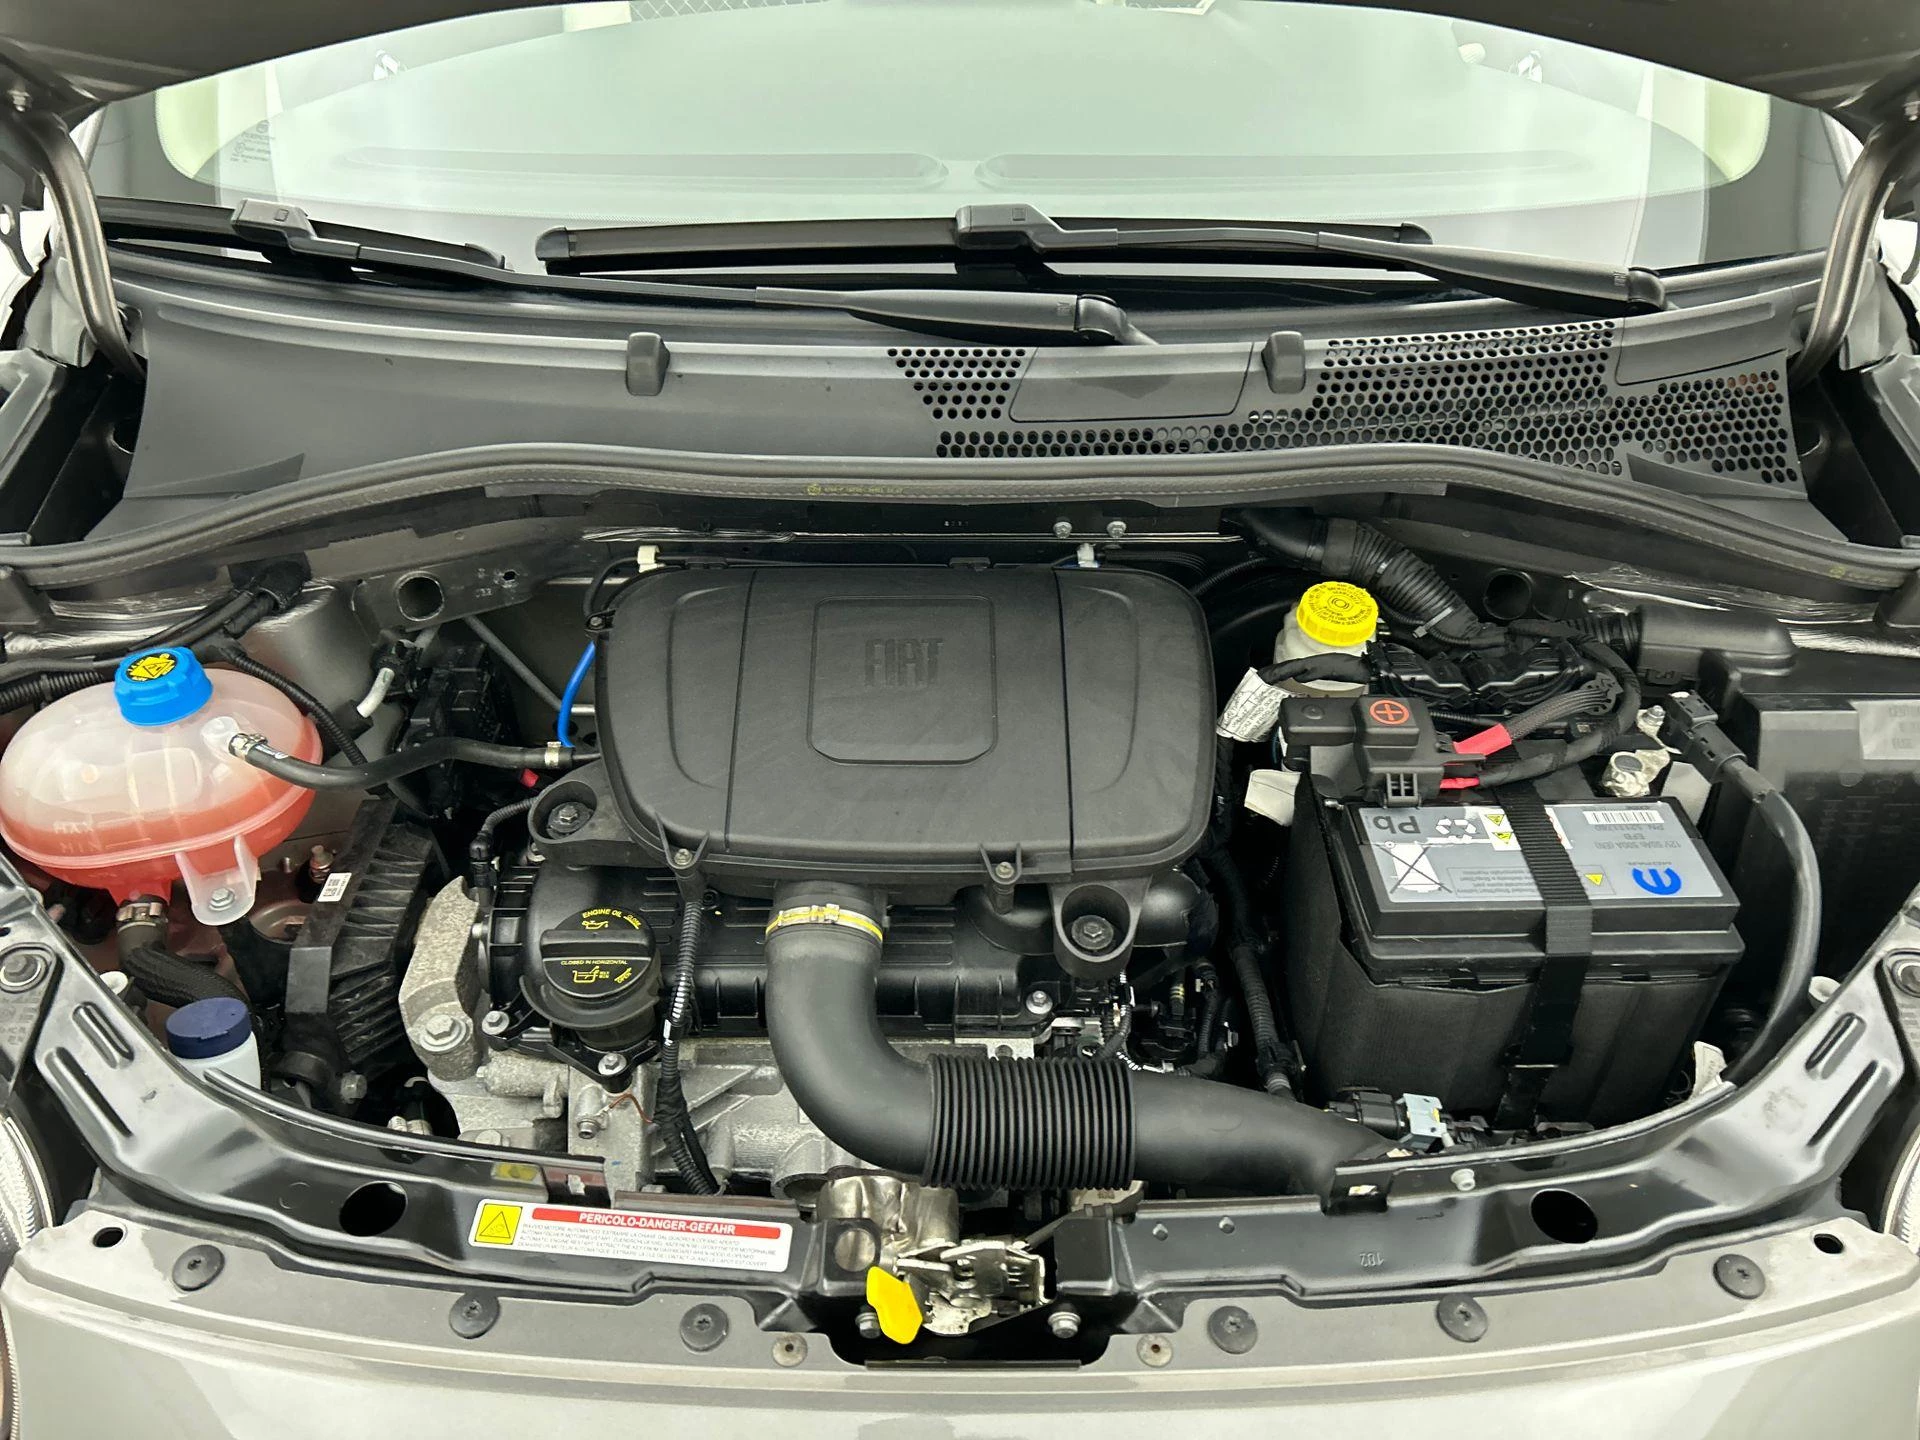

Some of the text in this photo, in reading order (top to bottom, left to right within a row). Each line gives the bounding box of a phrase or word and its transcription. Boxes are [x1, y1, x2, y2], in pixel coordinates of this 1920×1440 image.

[865, 638, 943, 687] FIAT
[53, 821, 94, 834] MAX
[1373, 815, 1421, 834] Pb
[582, 908, 622, 919] ENGINE OIL
[578, 1212, 736, 1236] PERICOLO-DANGER-GEFAHR
